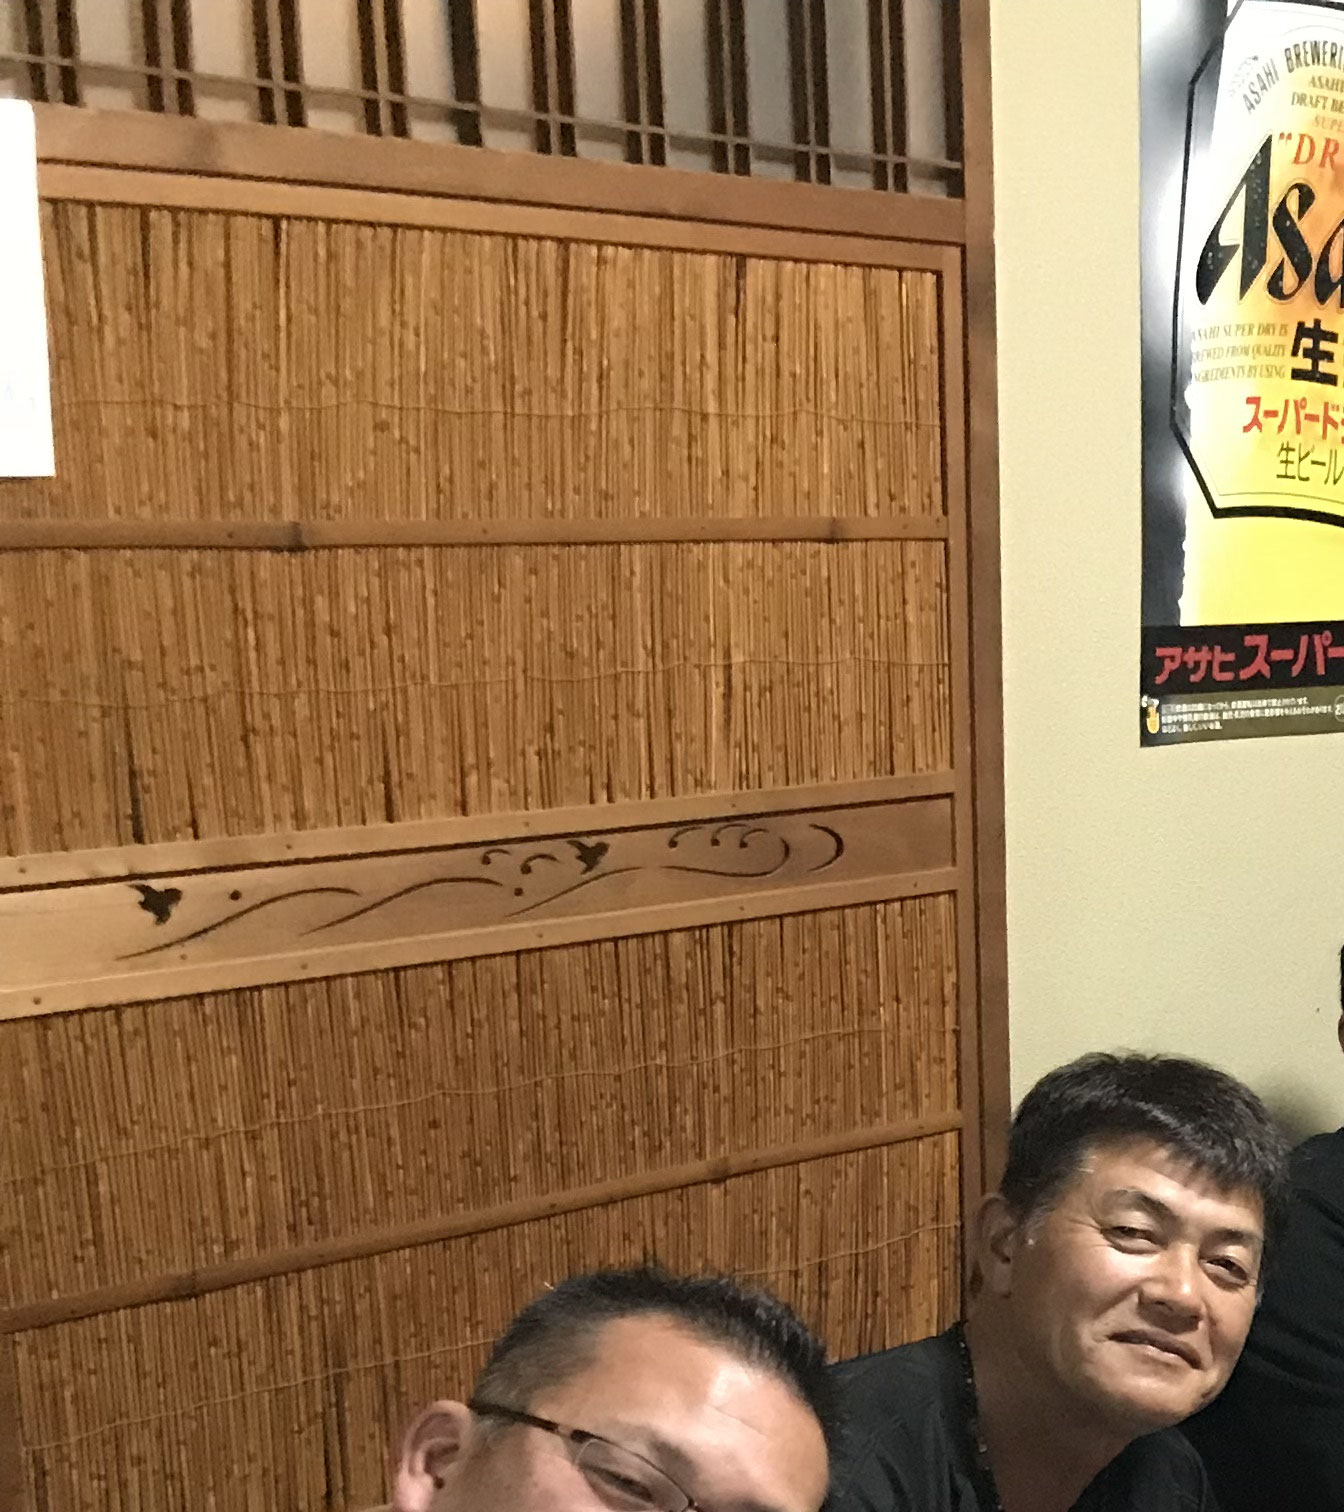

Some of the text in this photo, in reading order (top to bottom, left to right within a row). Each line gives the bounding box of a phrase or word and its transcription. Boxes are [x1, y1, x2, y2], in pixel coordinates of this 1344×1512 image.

[1242, 58, 1280, 115] ASAHI
[1291, 91, 1329, 112] DRAFT
[1223, 323, 1255, 337] SUPER
[1256, 322, 1276, 337] DRY
[1276, 323, 1288, 337] IS
[1224, 344, 1251, 360] FROM
[1251, 344, 1287, 361] QUALITY
[1290, 317, 1340, 387] 生
[1192, 365, 1247, 383] NGREDIENTS
[1259, 364, 1286, 380] USING
